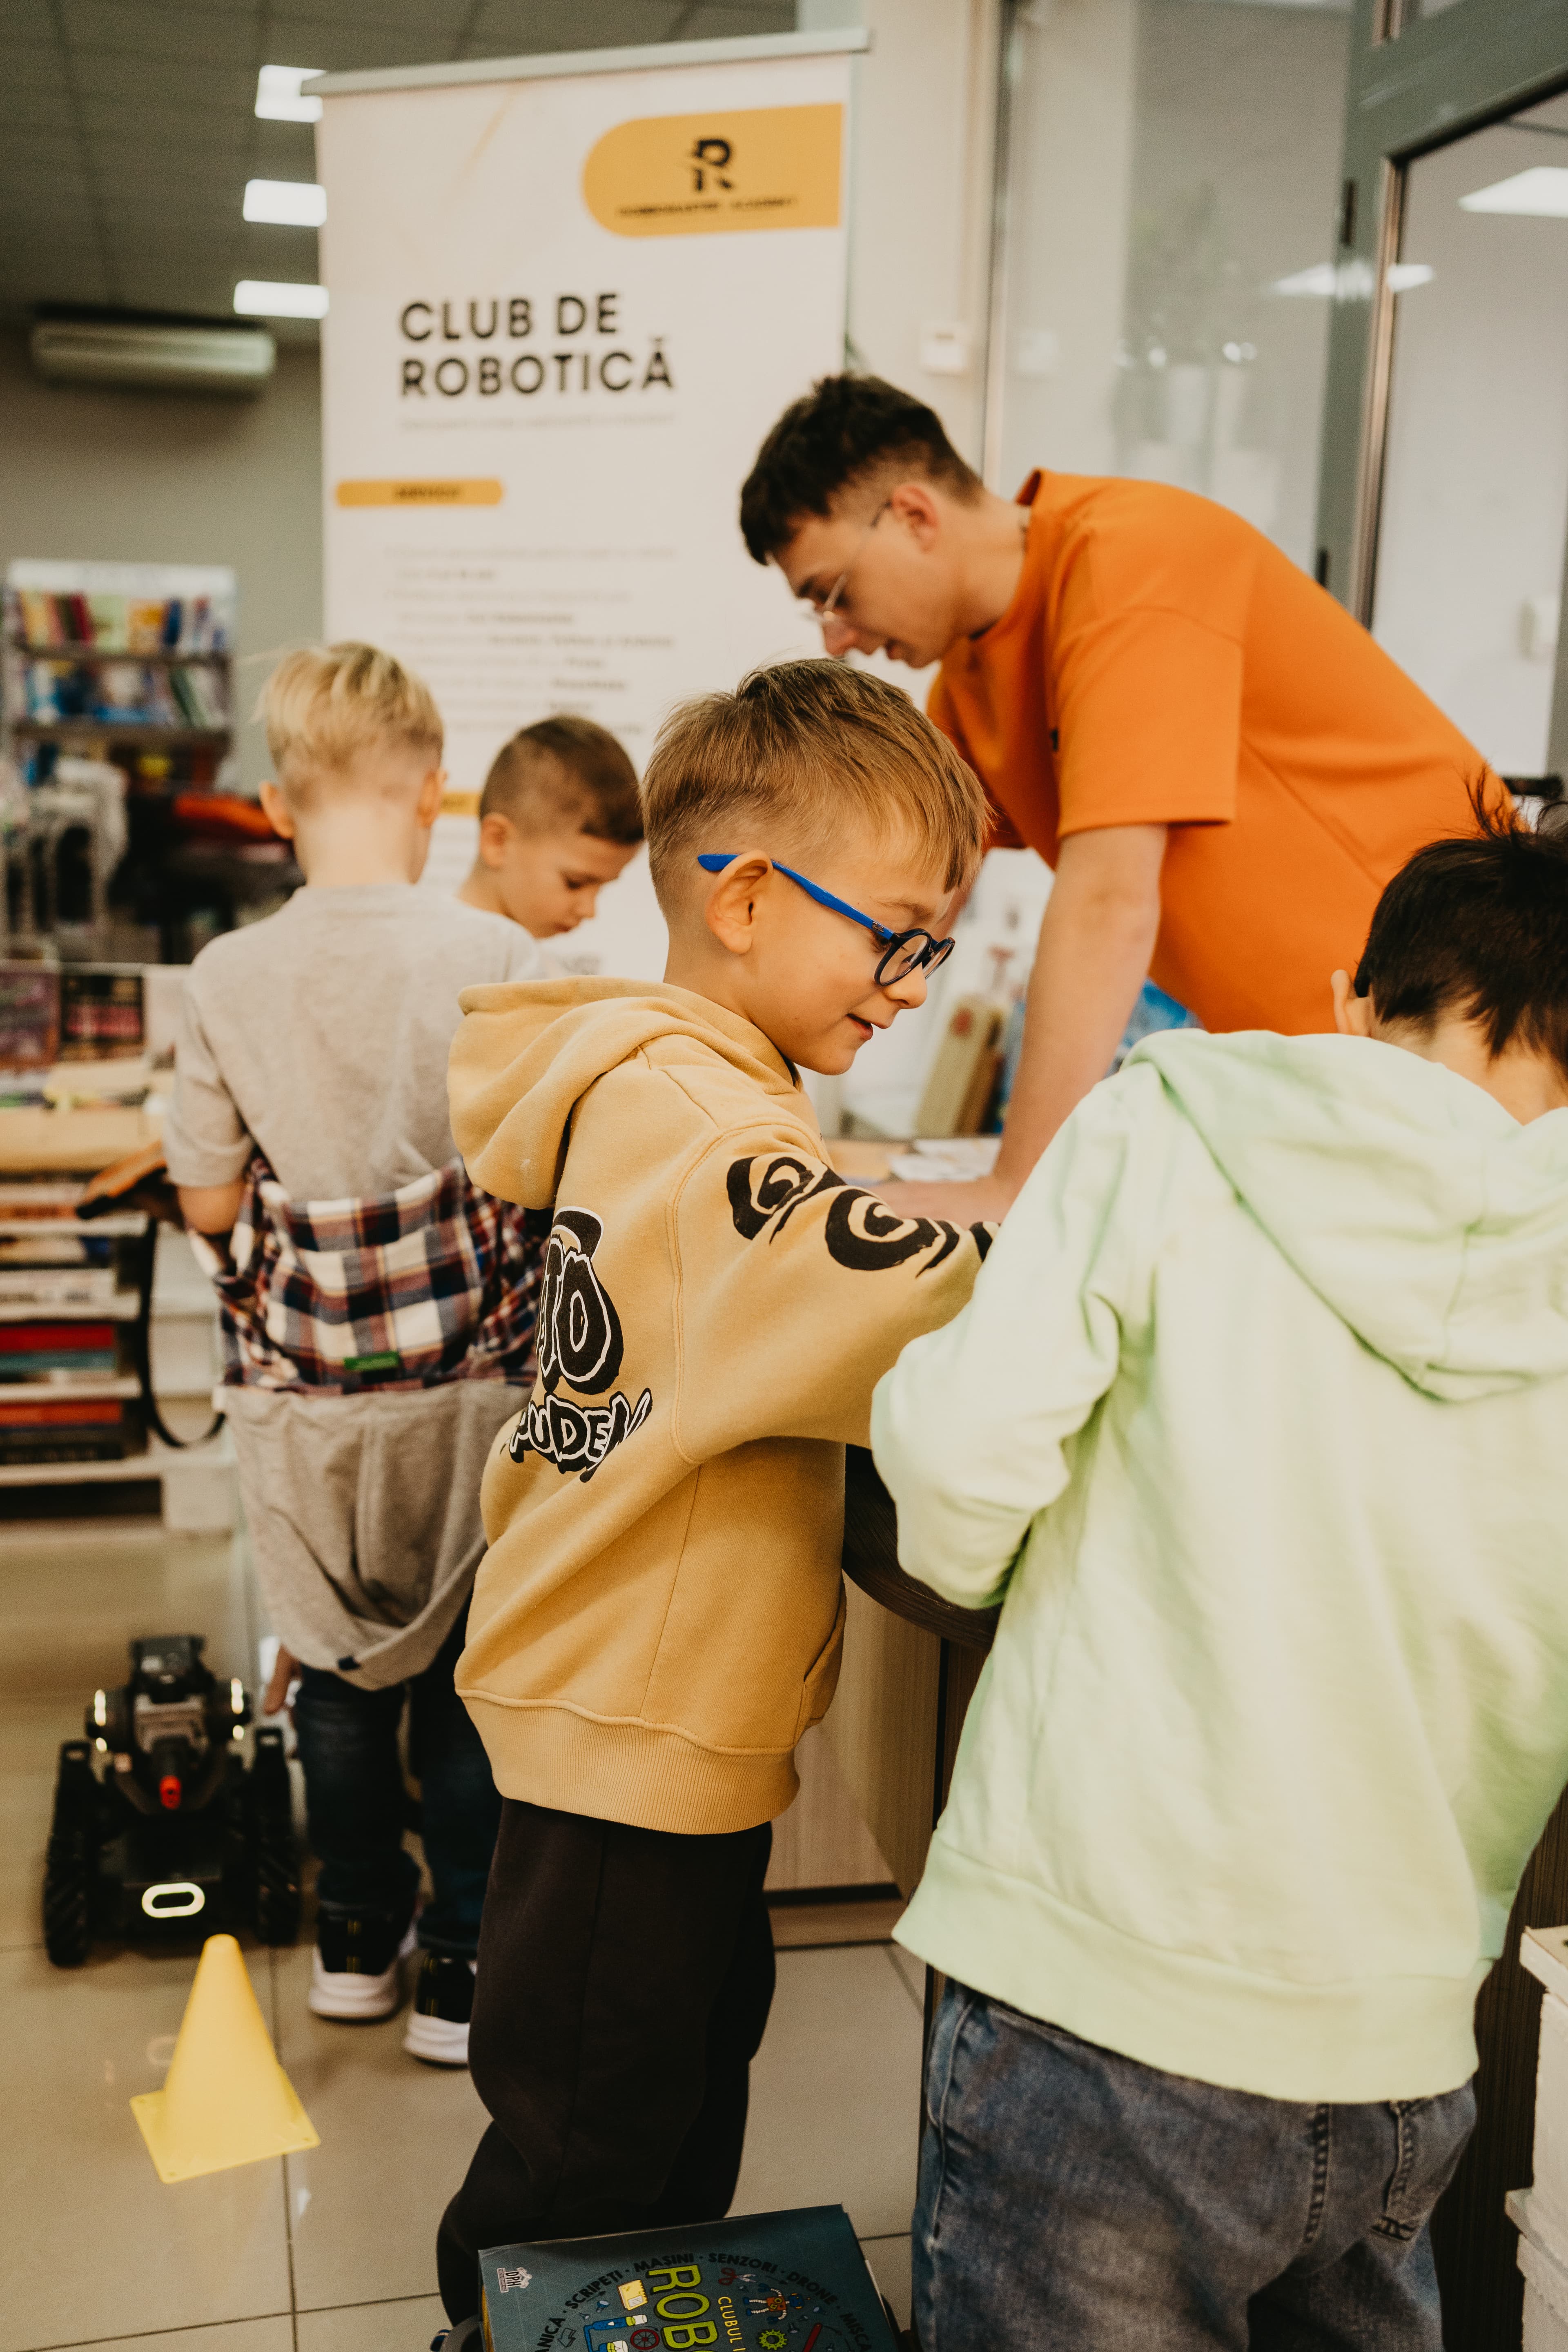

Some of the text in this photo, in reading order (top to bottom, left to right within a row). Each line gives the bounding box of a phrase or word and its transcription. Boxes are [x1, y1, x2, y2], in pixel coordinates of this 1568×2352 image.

[399, 293, 619, 342] CLUB DE
[399, 336, 675, 398] ROBOTICĂ
[505, 2271, 522, 2287] DPH
[565, 2270, 624, 2309] SCRIPETI
[633, 2253, 694, 2272] MASINI
[708, 2252, 779, 2274] SENZORI
[786, 2271, 839, 2305] DRONE
[718, 2296, 743, 2343] CLUBUL
